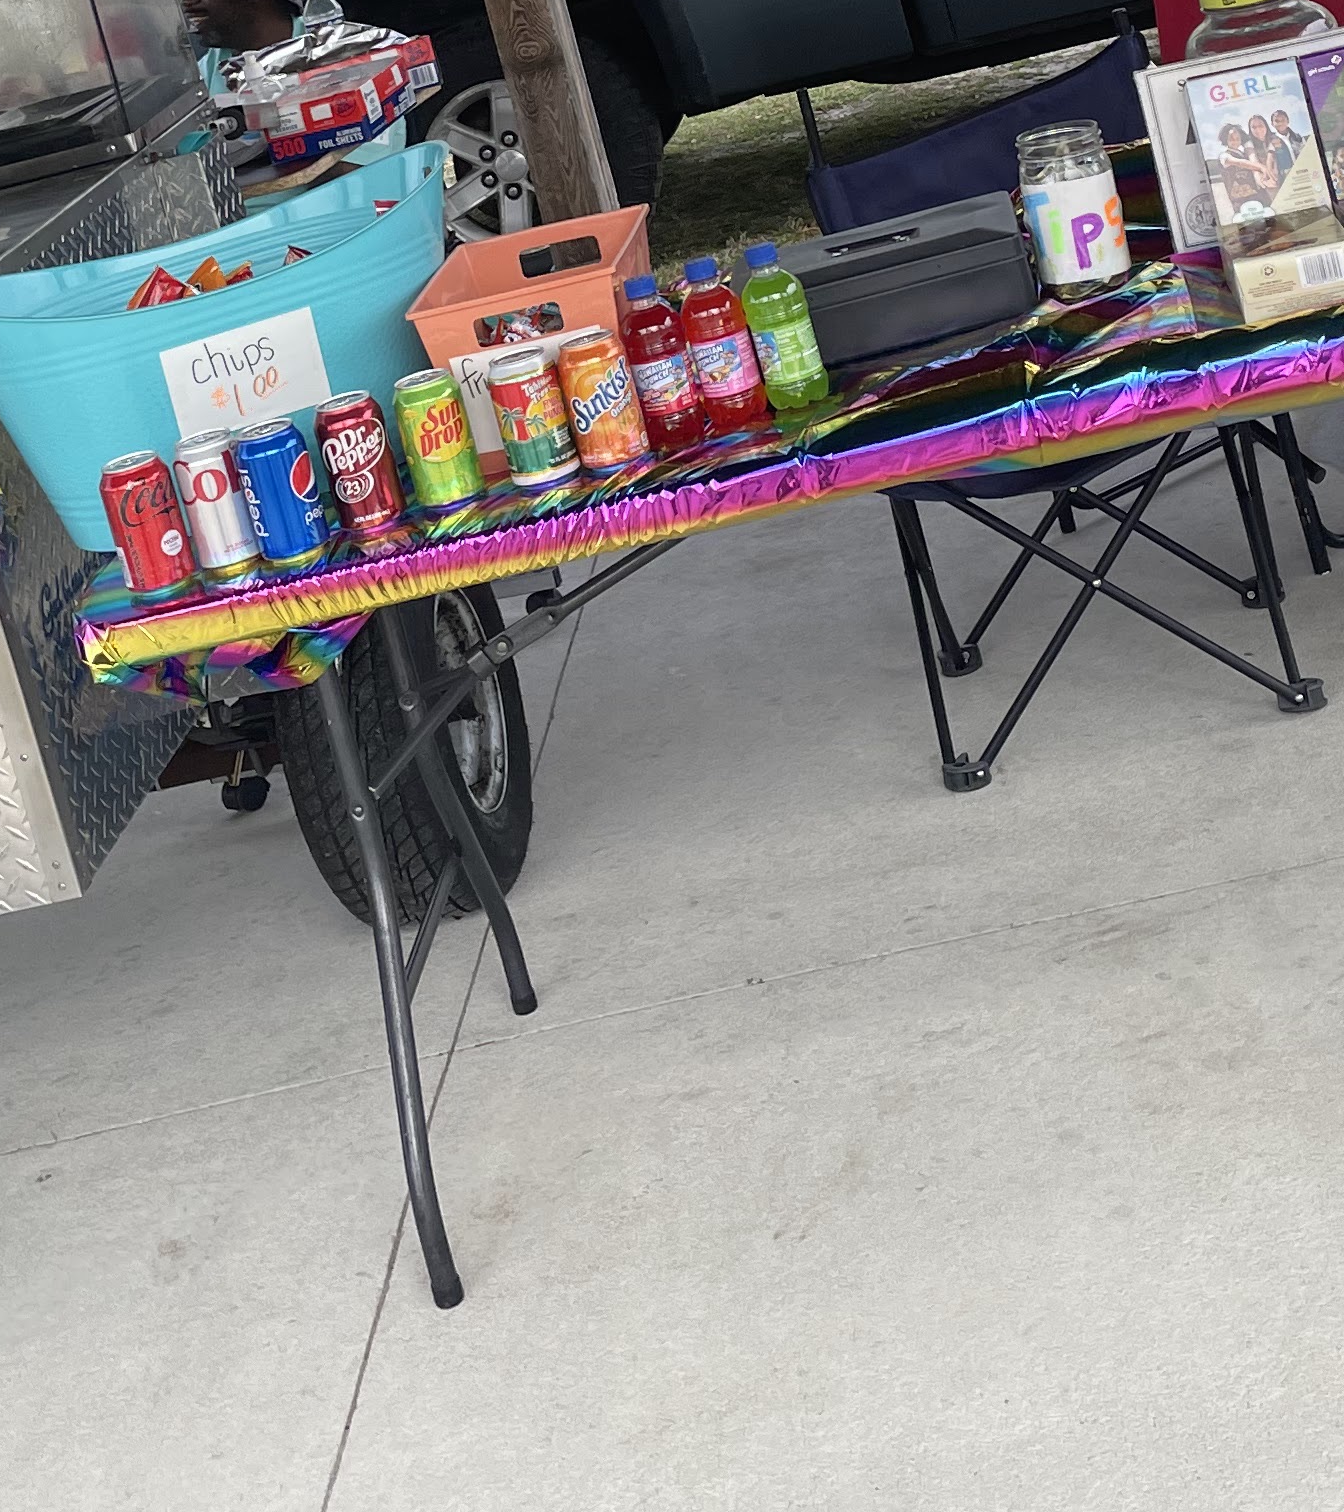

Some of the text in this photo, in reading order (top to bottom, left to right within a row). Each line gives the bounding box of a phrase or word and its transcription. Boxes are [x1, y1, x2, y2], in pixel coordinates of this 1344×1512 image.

[272, 137, 307, 160] 500
[317, 138, 337, 150] FOIL
[191, 336, 275, 385] chips
[570, 355, 629, 435] Sunkist
[420, 398, 462, 433] Sun
[326, 426, 382, 476] Pepper
[339, 425, 367, 454] Dr
[419, 418, 464, 459] Drop
[238, 467, 270, 538] pepsi
[344, 480, 361, 496] 23
